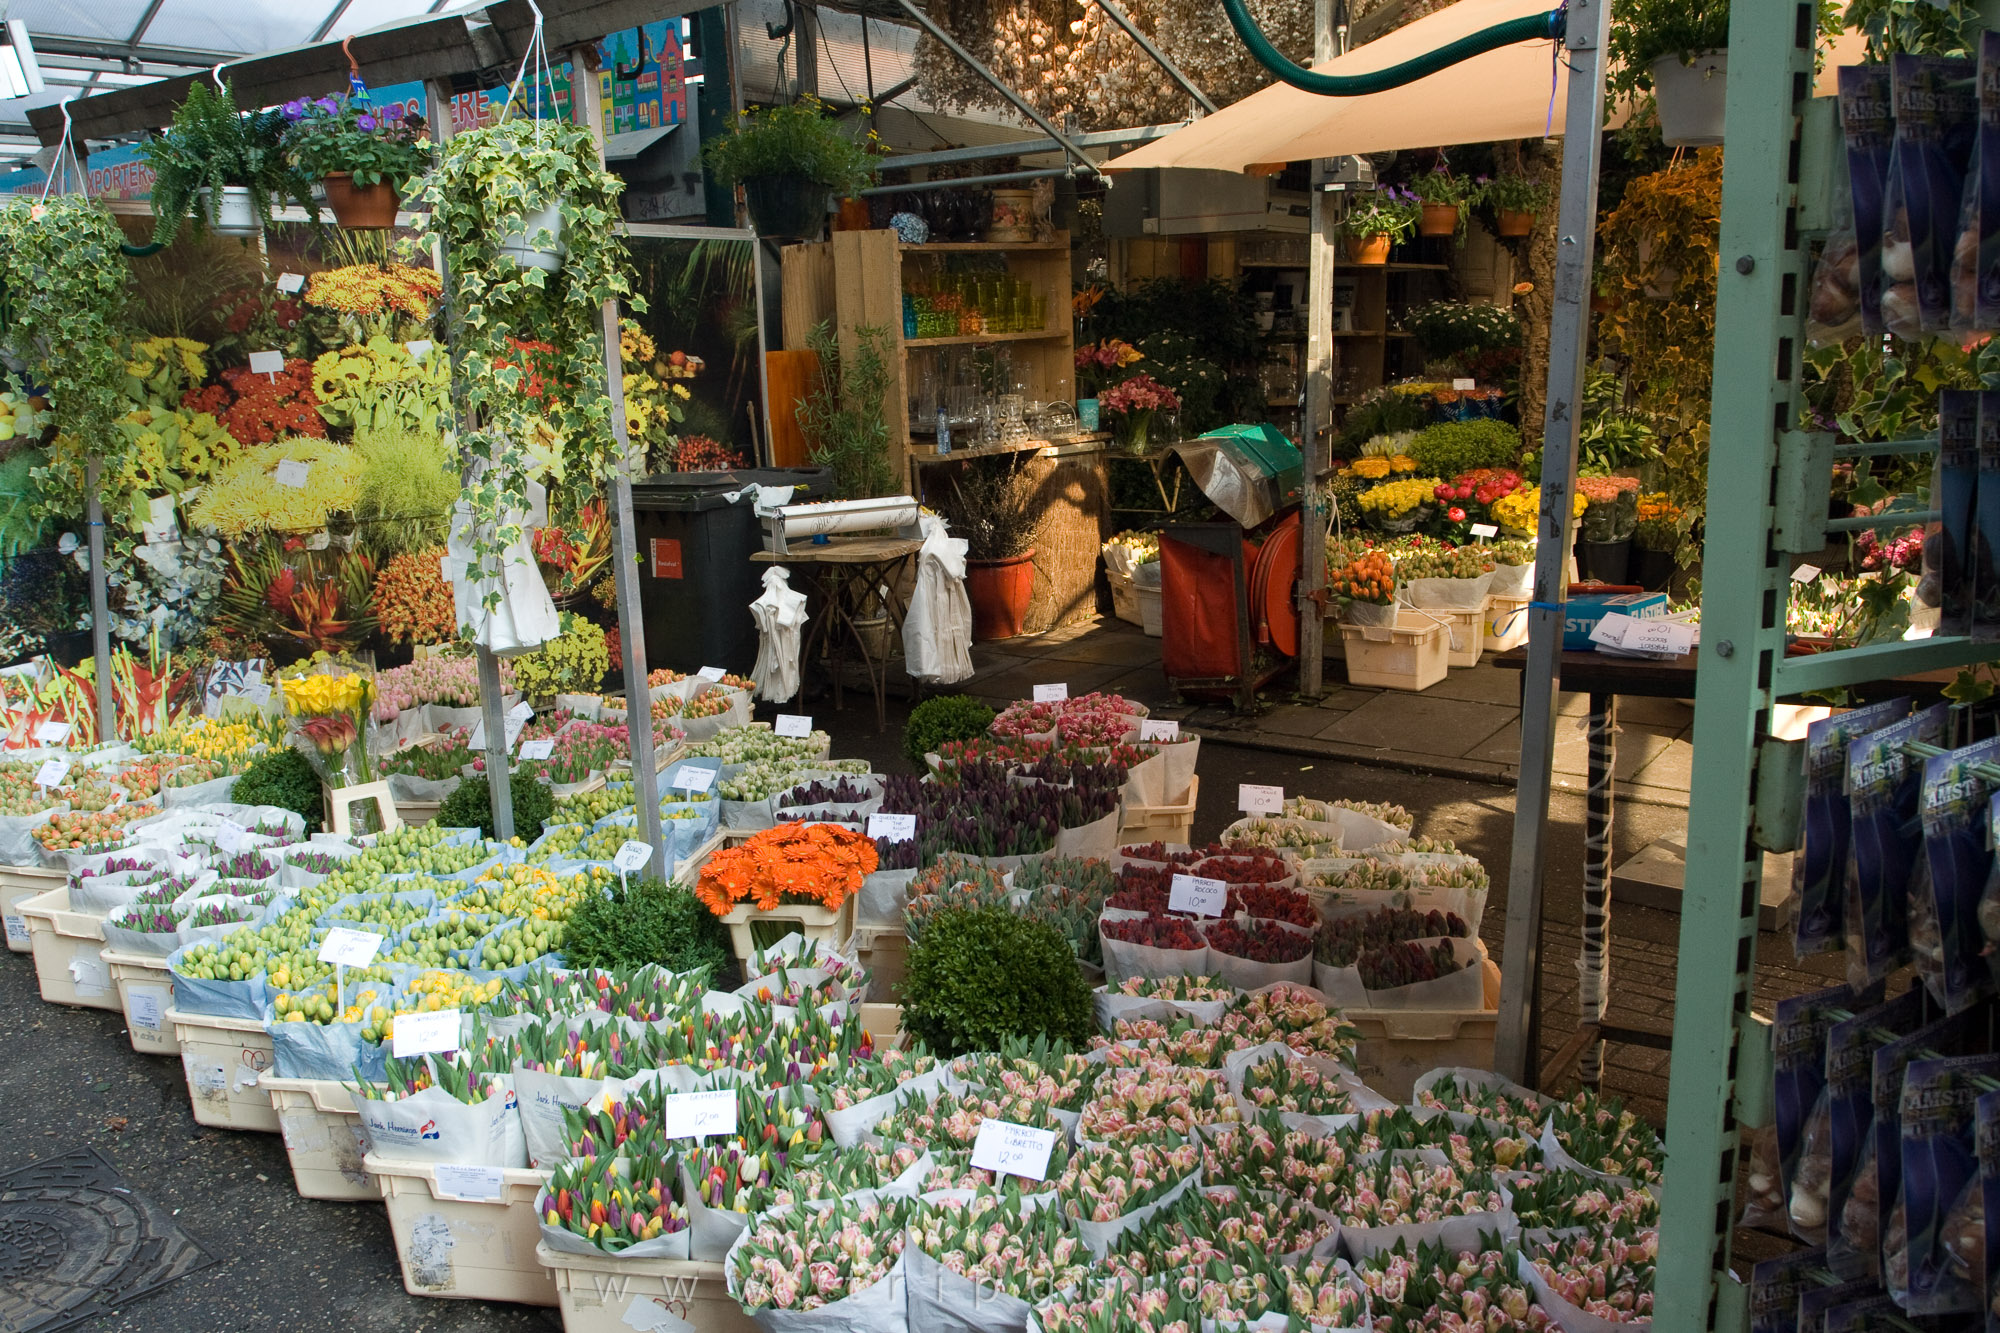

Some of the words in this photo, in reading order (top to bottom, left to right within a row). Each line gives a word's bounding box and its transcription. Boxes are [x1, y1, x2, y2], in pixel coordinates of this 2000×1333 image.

[1832, 707, 1871, 724] GREETINGS
[1872, 700, 1893, 715] FROM
[1873, 718, 1911, 741] GREETINGS
[1912, 708, 1931, 724] FROM
[1952, 741, 1994, 760] GREETINGS
[1191, 877, 1216, 887] PARROT
[1194, 885, 1218, 894] ROCOCO
[368, 1118, 386, 1130] Jack
[1005, 1125, 1038, 1137] PARROT
[1005, 1137, 1043, 1151] LIBRETTO
